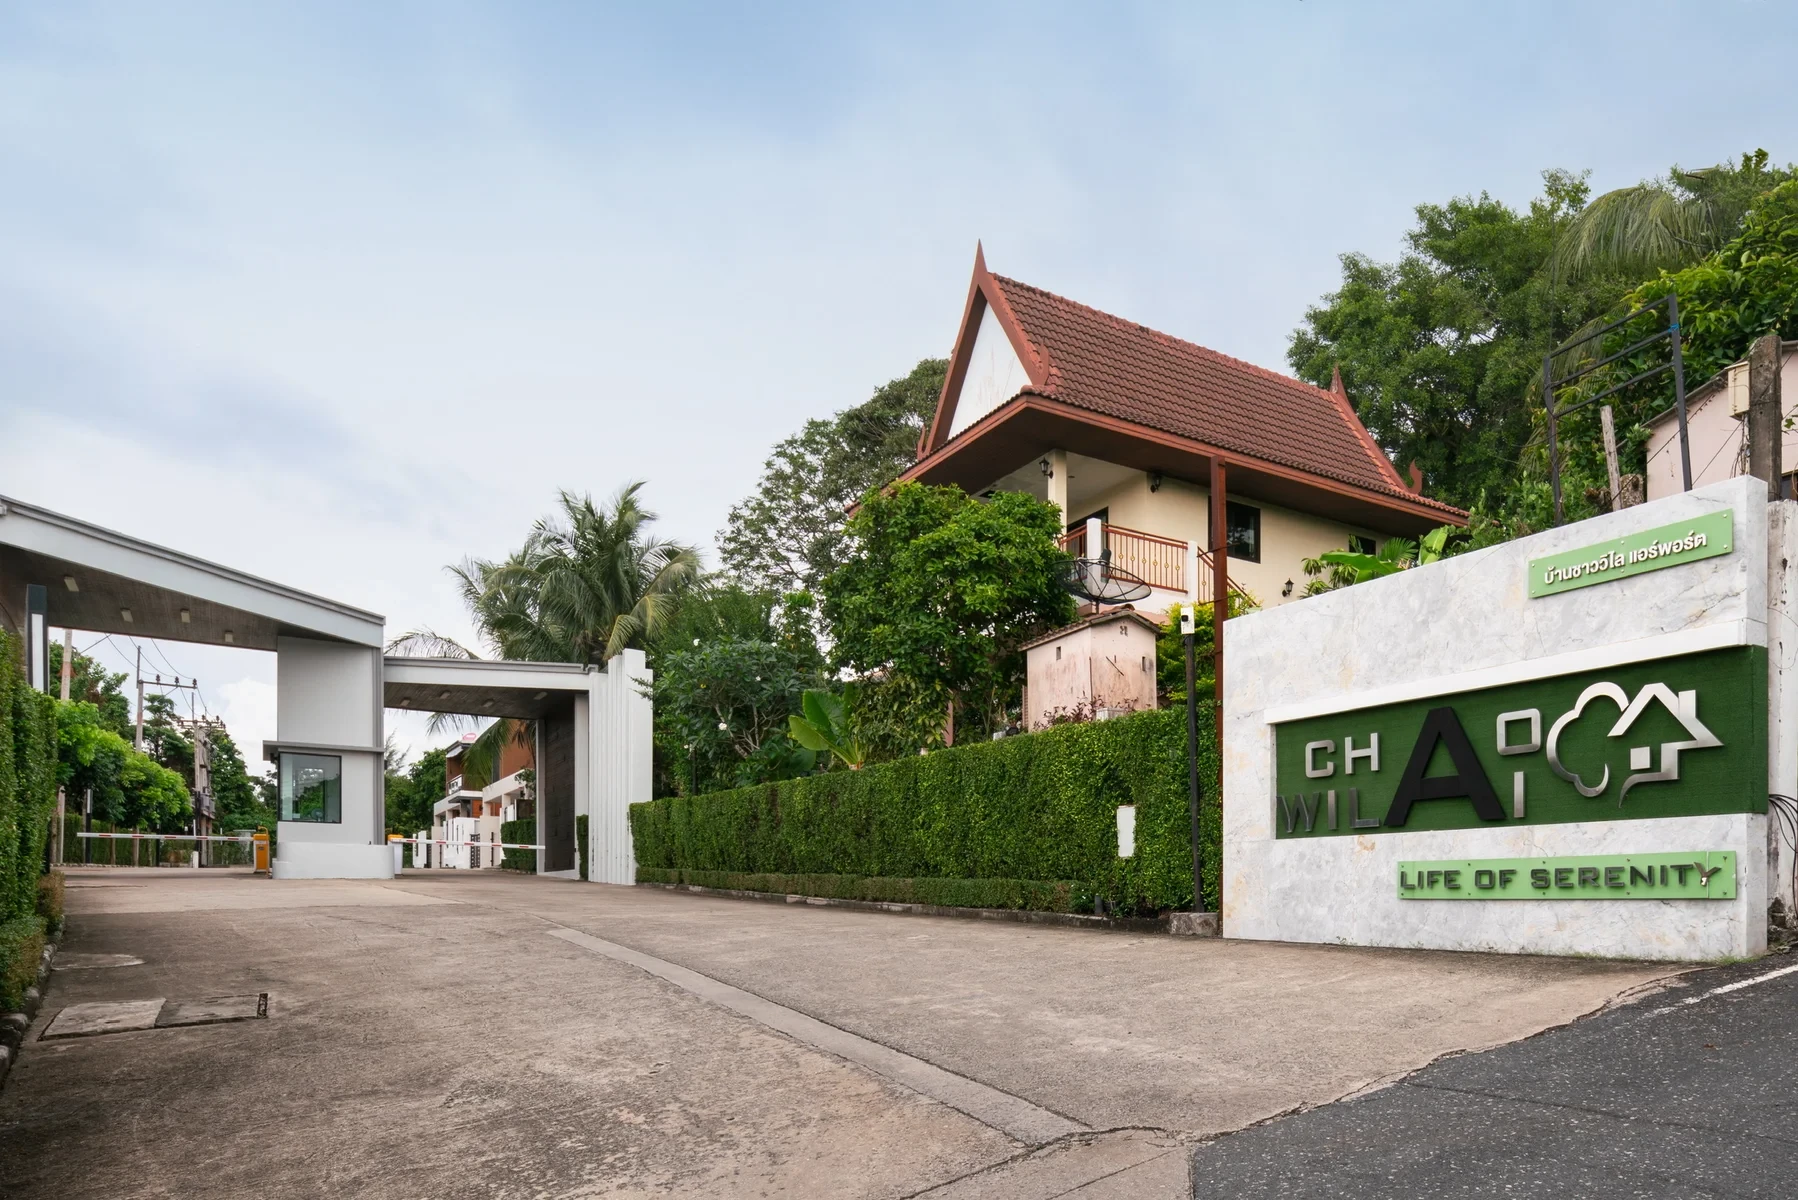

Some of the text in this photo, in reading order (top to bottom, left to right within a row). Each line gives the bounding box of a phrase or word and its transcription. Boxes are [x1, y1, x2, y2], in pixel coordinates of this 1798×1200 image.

[1629, 530, 1707, 564] แอร์พอร์ต
[1400, 861, 1722, 890] LIFE OF SERENITY
